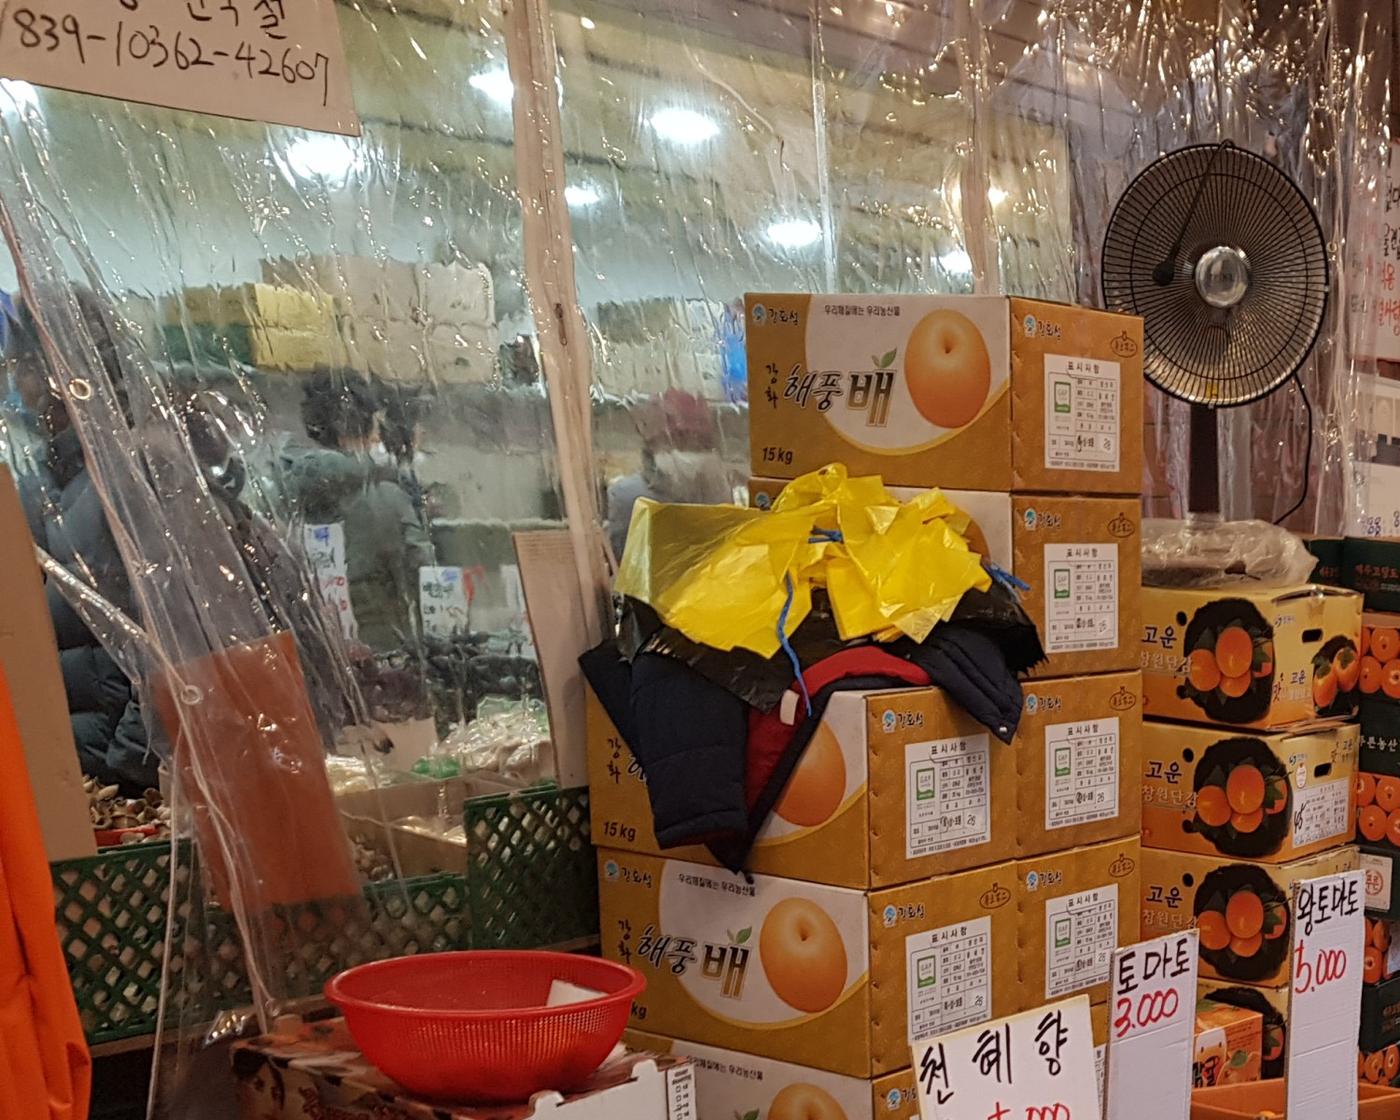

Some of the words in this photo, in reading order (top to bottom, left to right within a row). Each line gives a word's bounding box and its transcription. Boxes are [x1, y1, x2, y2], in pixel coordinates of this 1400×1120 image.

[784, 362, 843, 413] 해풍
[847, 368, 898, 428] 배
[1141, 625, 1177, 650] 고운
[1144, 760, 1182, 785] 고운
[1145, 886, 1183, 910] 고운
[1297, 877, 1360, 936] 왕토마토
[637, 924, 698, 976] 해풍
[702, 941, 753, 1001] 배
[1116, 943, 1192, 996] 토마토
[1113, 987, 1180, 1039] 3.000
